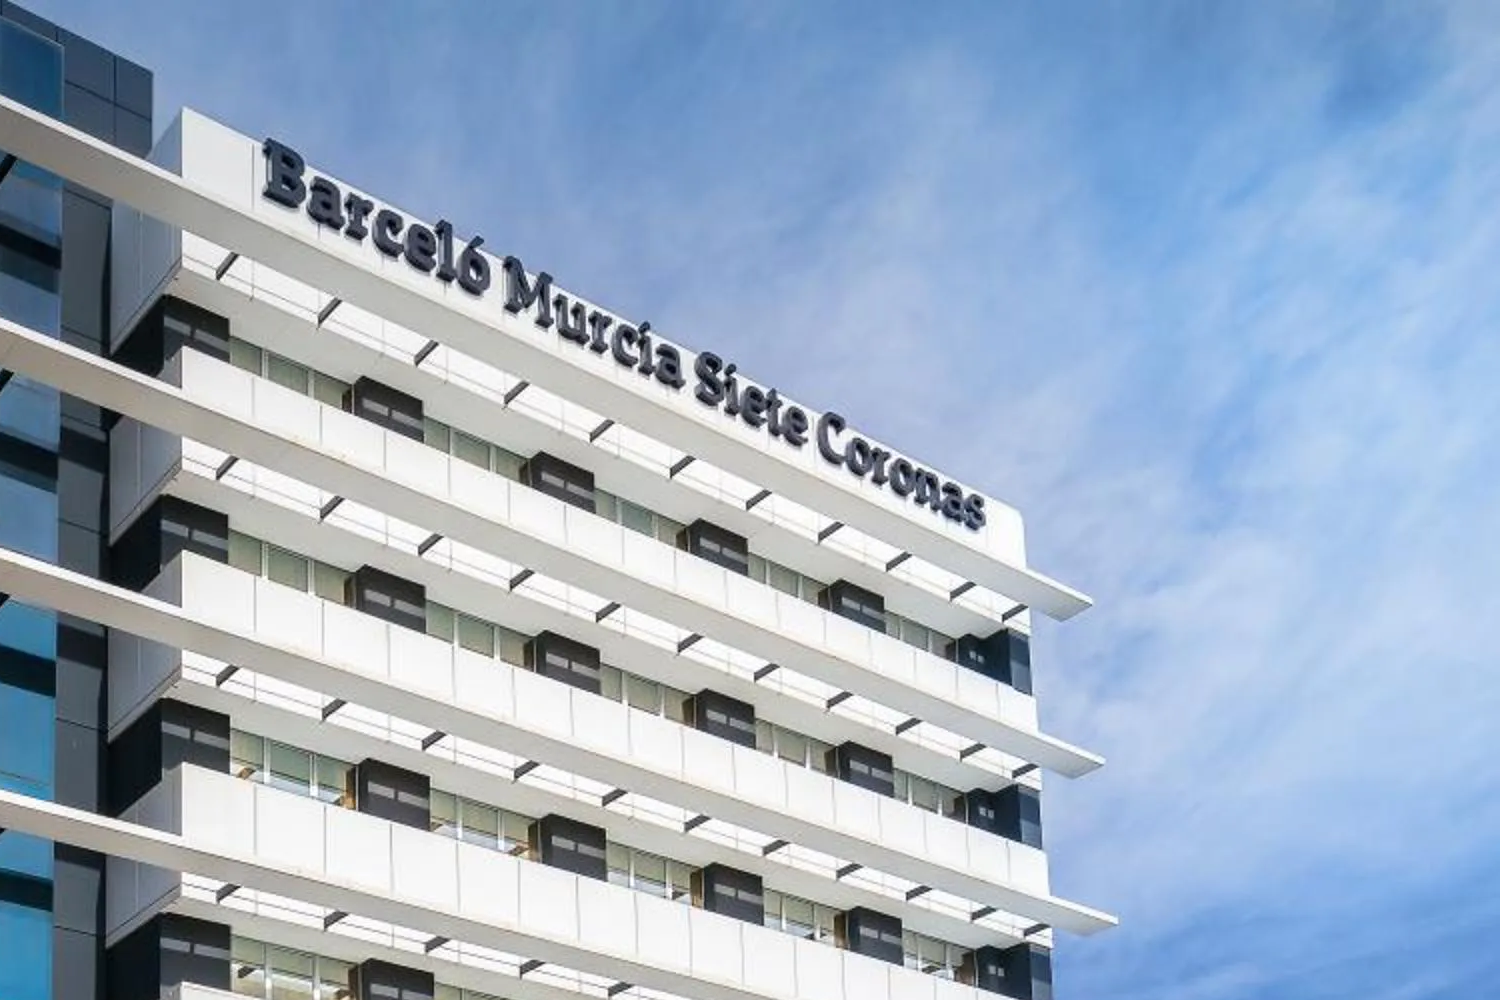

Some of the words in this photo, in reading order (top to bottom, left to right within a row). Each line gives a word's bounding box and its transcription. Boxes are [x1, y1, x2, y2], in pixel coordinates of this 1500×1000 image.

[263, 137, 491, 296] Barceló
[503, 255, 686, 390] Murcia
[694, 351, 809, 447] Siete
[817, 412, 986, 531] Coronas
